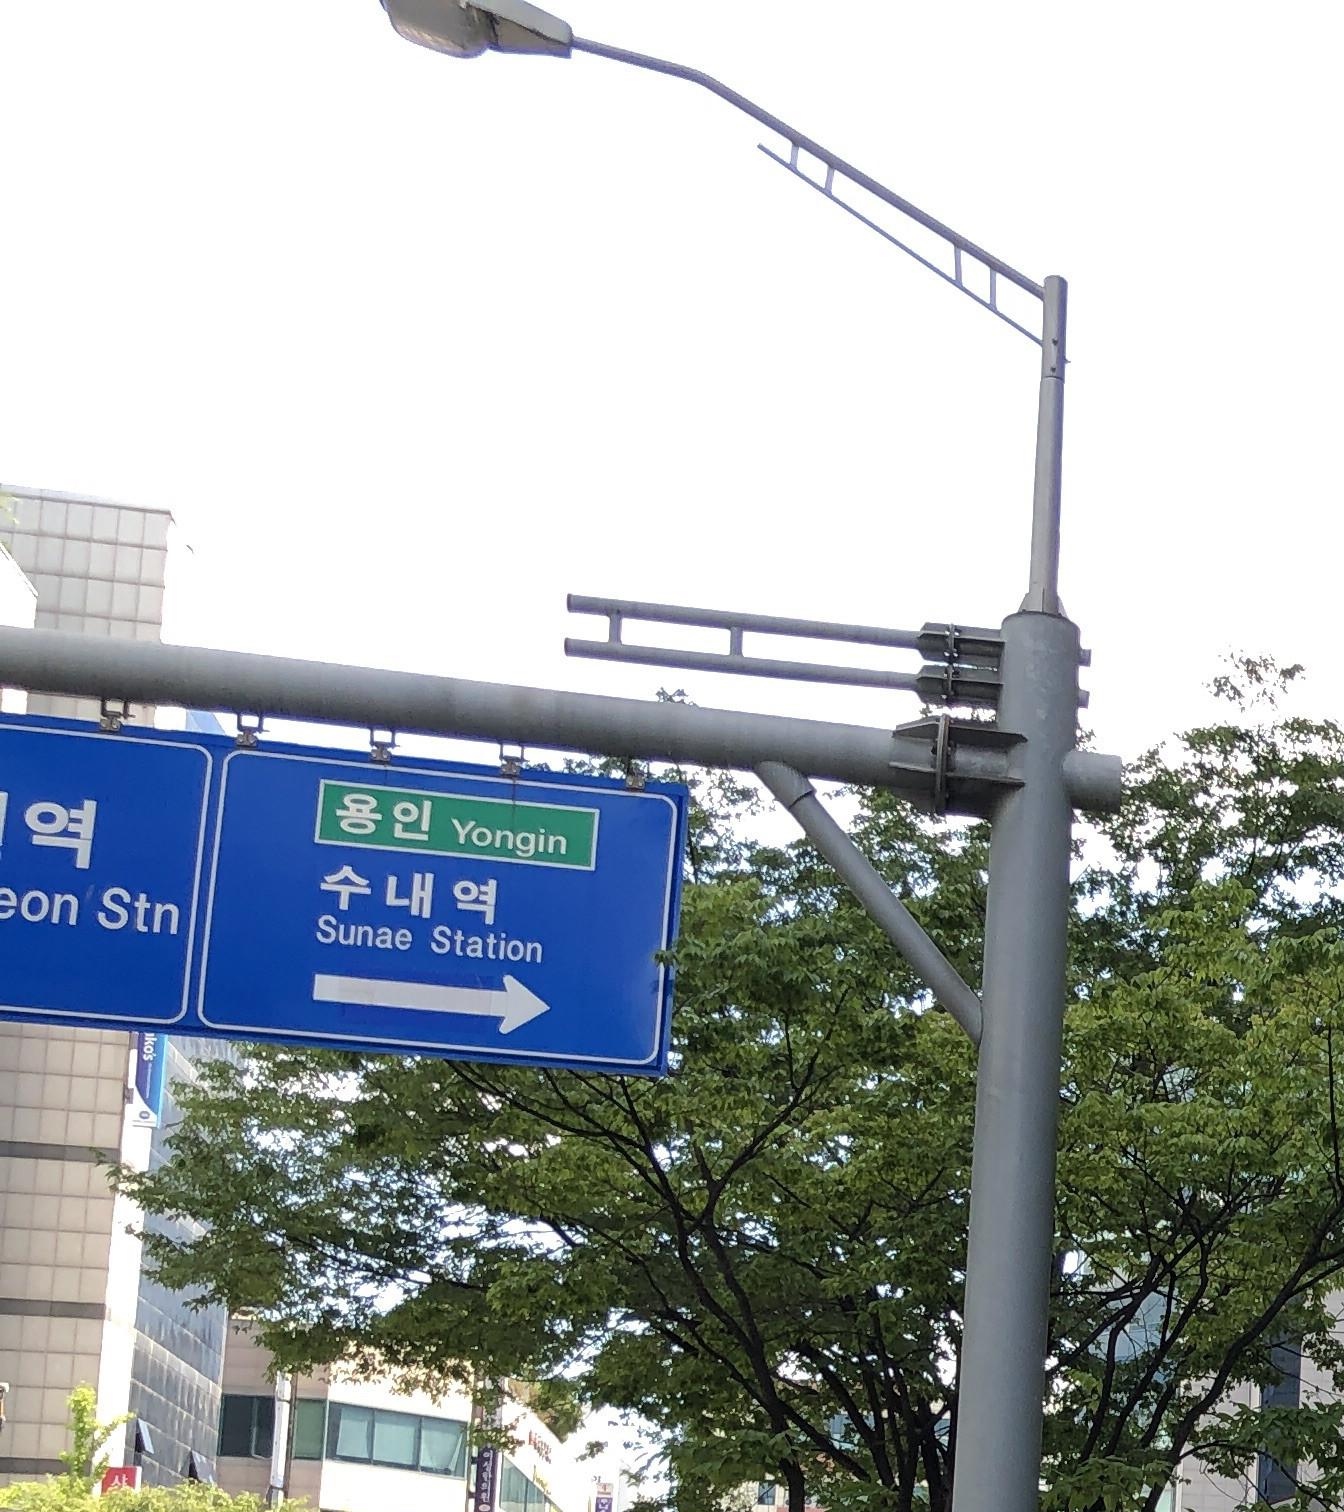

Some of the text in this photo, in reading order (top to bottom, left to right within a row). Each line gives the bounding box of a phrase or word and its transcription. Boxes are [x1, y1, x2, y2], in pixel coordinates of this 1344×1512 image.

[0, 791, 97, 869] 역
[335, 793, 568, 859] 용인 Yongin
[97, 886, 179, 935] Stn
[320, 865, 498, 925] 수내역
[316, 915, 544, 964] Sunae Station
